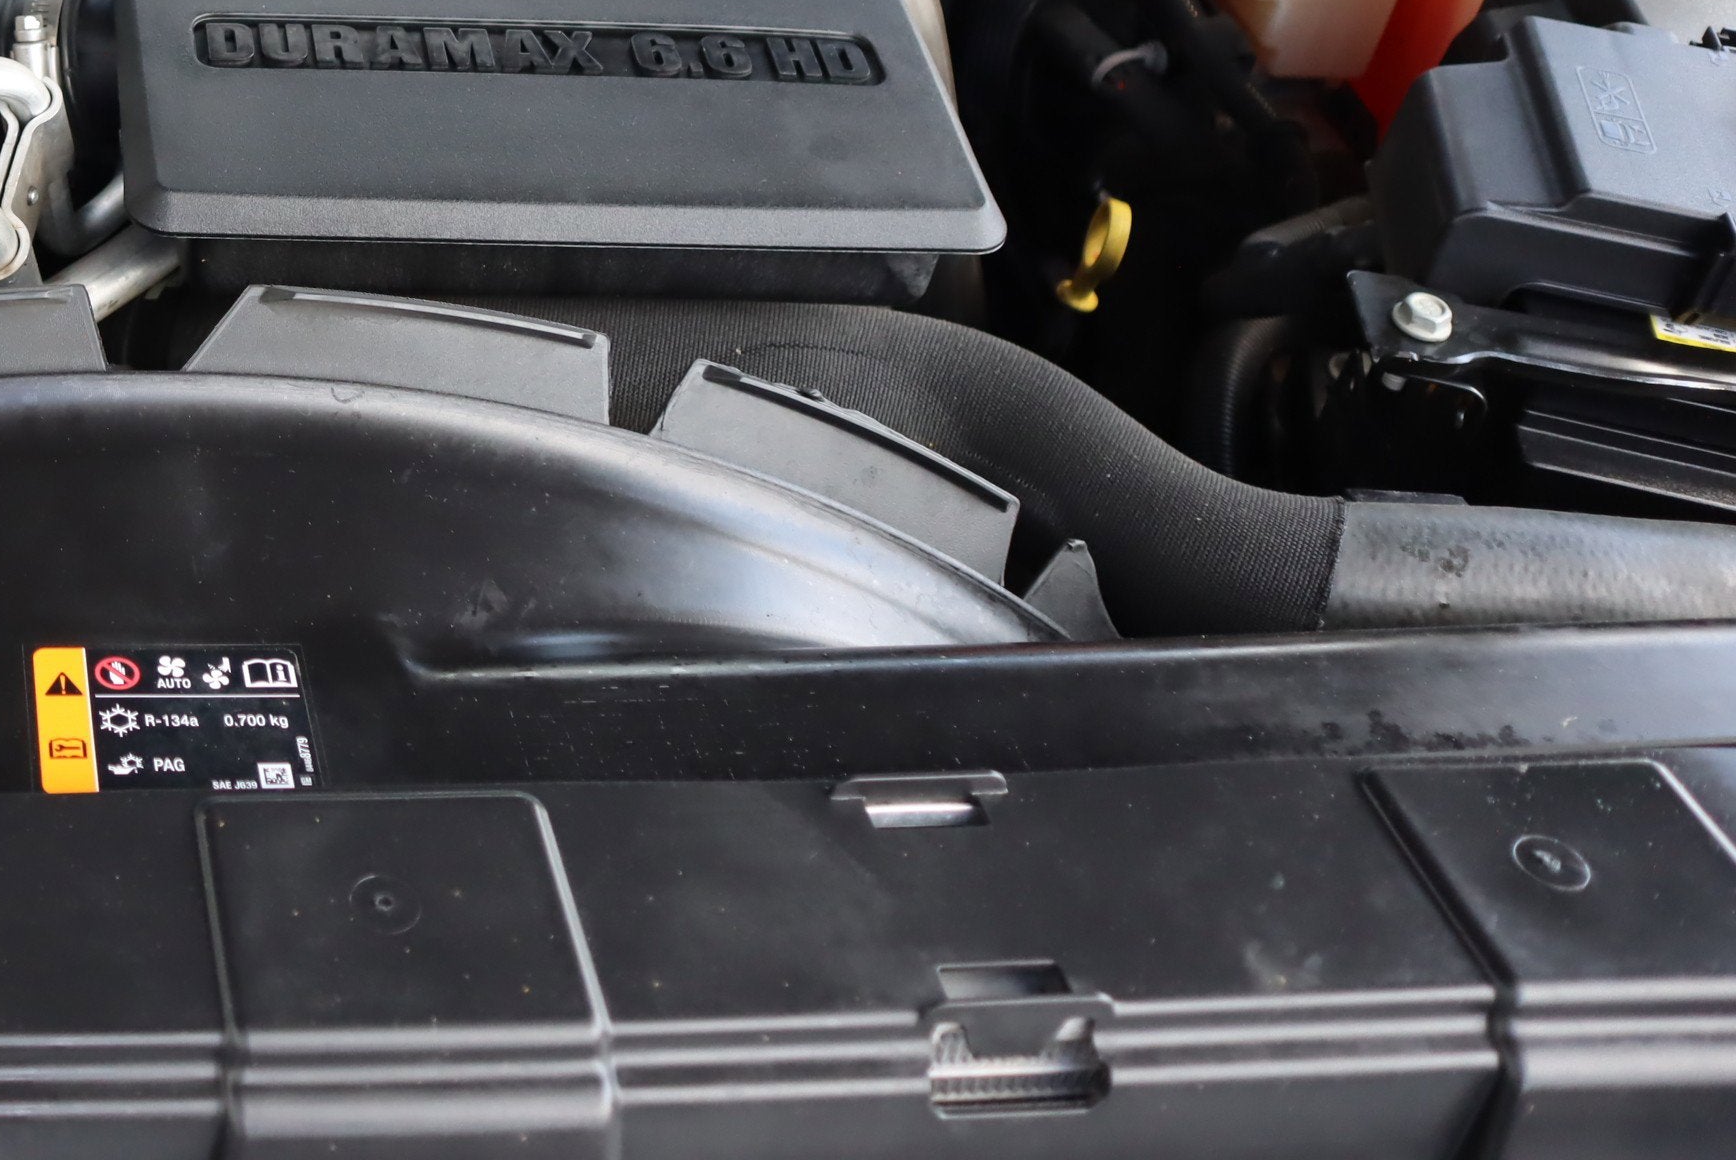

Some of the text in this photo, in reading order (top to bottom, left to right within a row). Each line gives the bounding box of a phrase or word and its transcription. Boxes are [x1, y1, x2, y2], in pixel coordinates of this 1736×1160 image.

[205, 22, 871, 82] DURAMAX 6.6 HD
[157, 678, 192, 689] AUTO
[144, 713, 289, 729] R-134a 0.700 kg
[153, 757, 185, 772] PAG
[212, 780, 258, 790] SAE J639
